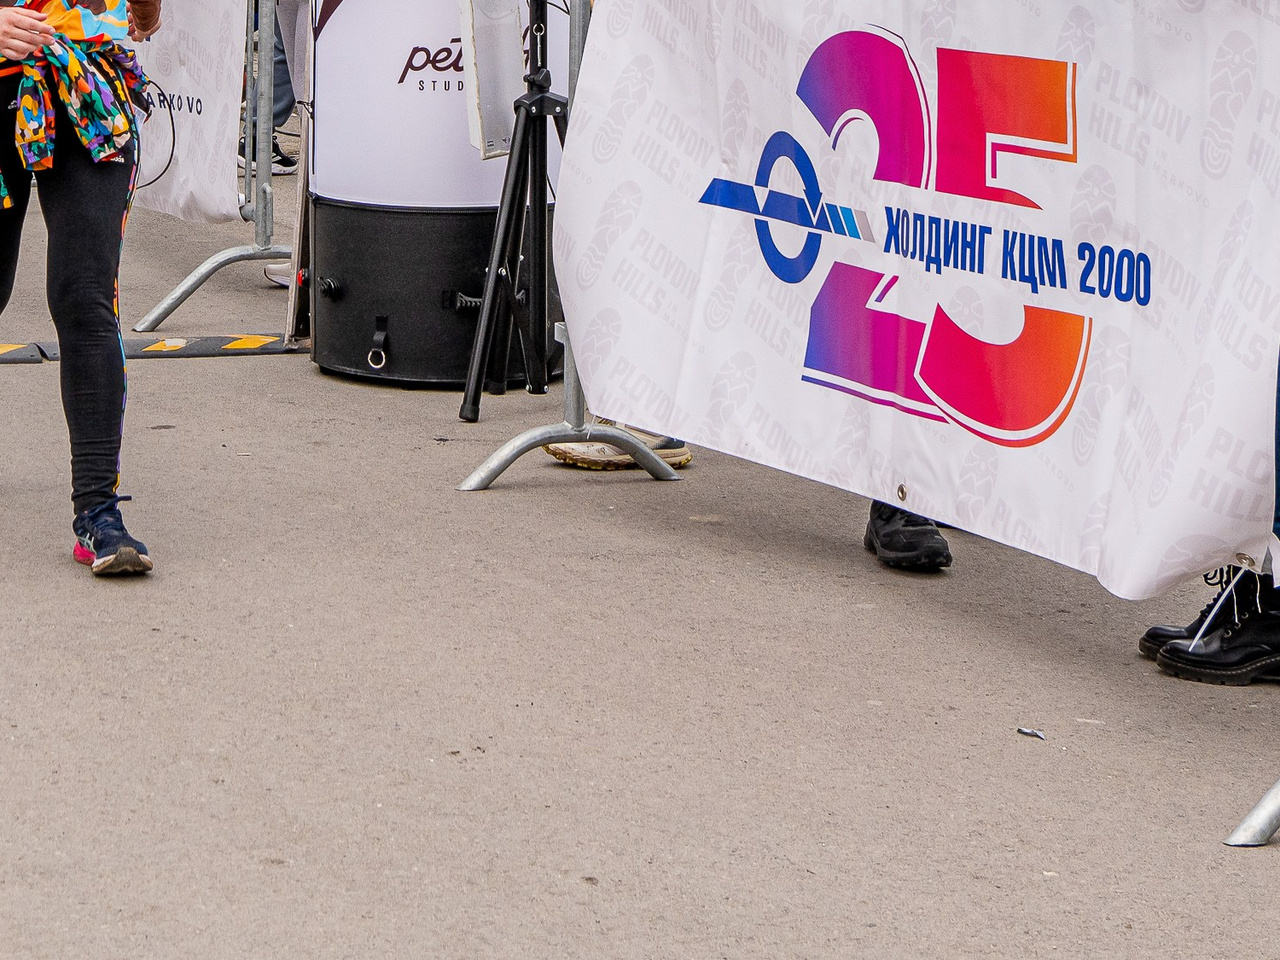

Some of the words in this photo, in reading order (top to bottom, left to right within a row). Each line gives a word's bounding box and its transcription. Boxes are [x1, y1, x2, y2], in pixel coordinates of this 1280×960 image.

[418, 79, 464, 91] STUD
[145, 92, 203, 116] ARKOVO
[884, 206, 992, 275] ХОЛДИНГ
[1002, 229, 1067, 294] КЦМ
[1077, 242, 1151, 307] 2000
